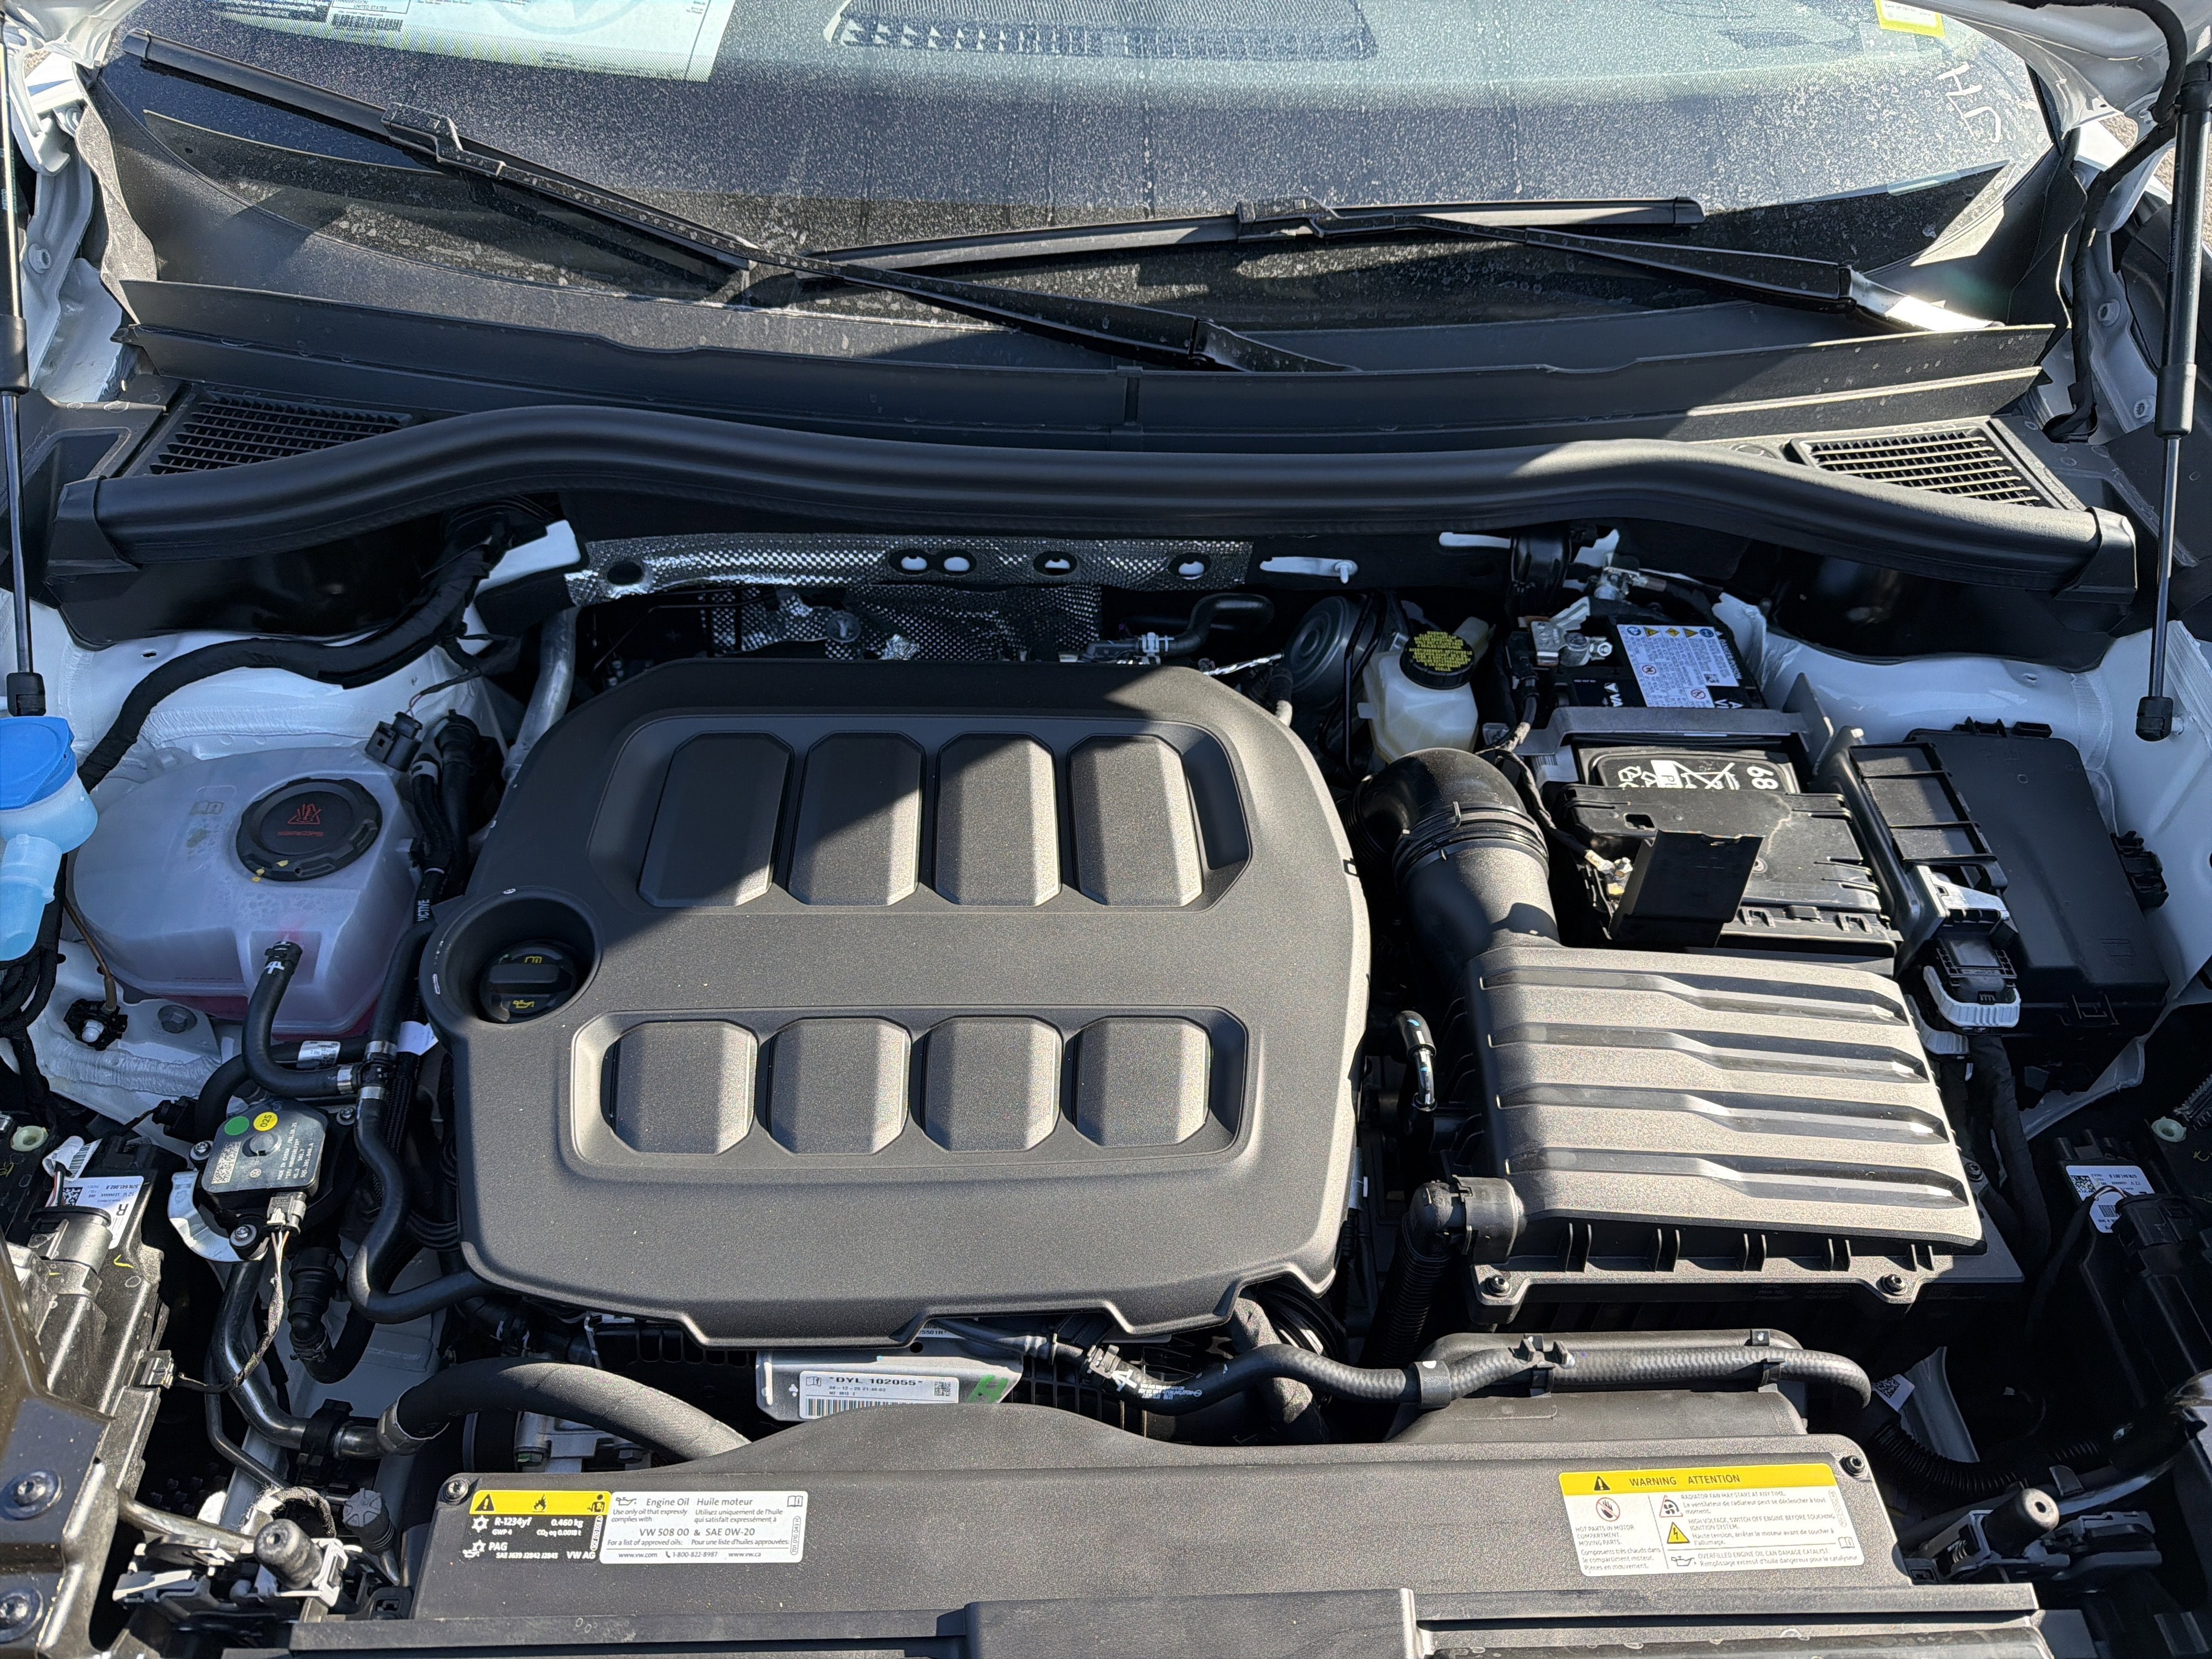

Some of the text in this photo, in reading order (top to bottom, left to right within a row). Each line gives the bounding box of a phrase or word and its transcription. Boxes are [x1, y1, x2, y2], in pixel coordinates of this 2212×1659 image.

[116, 1203, 129, 1216] R
[1629, 1474, 1740, 1486] WARNING ATTENTION
[646, 1498, 675, 1508] Engine
[677, 1498, 690, 1506] Oil
[697, 1498, 720, 1506] Huile
[718, 1509, 754, 1517] uniquement
[494, 1516, 532, 1528] R-1234yf
[574, 1519, 584, 1528] kg
[730, 1516, 772, 1524] expressément
[706, 1528, 723, 1536] SAE
[724, 1528, 755, 1536] 0W-20
[488, 1542, 508, 1550] PAG
